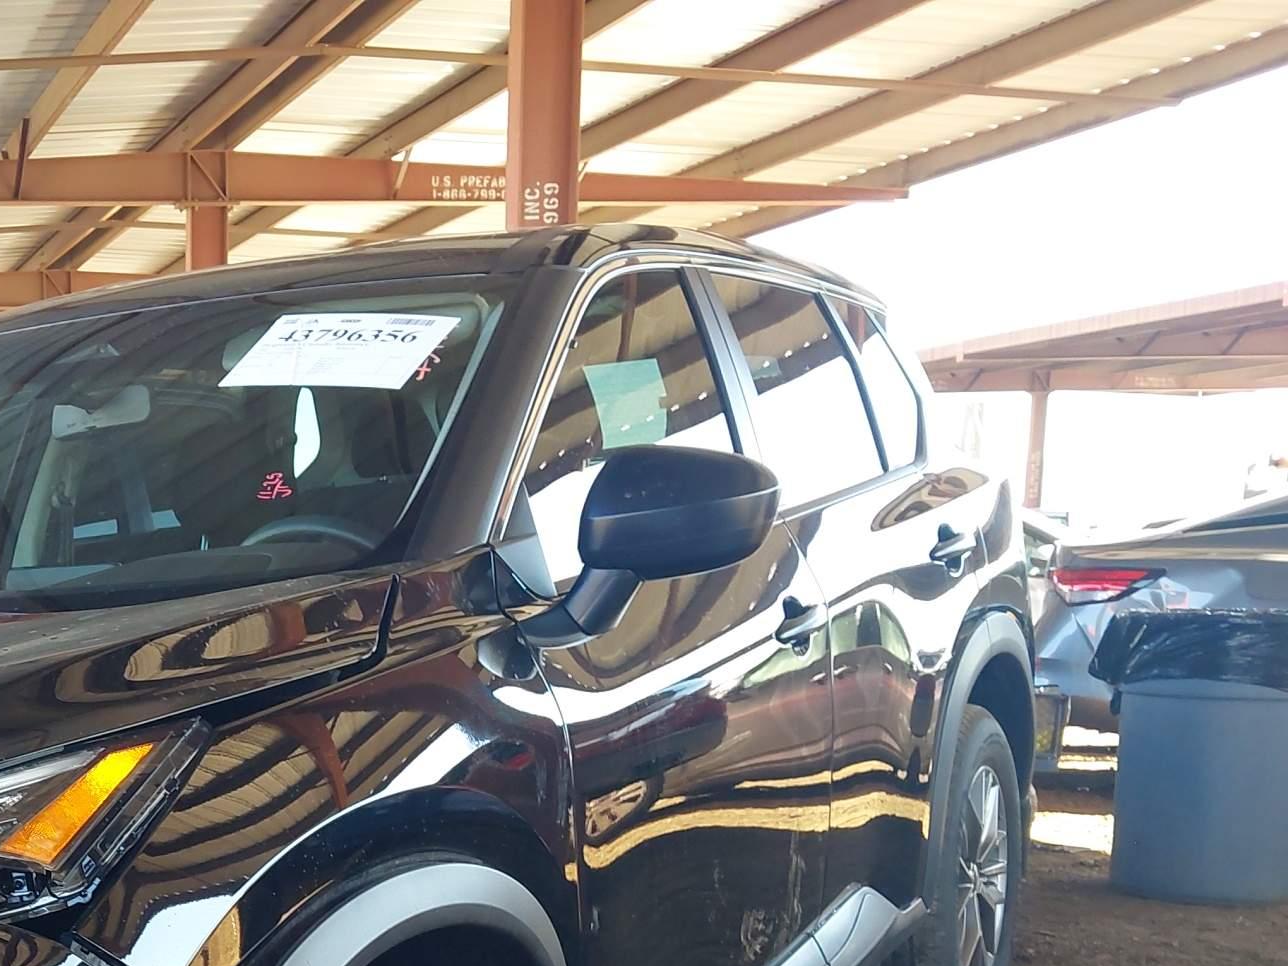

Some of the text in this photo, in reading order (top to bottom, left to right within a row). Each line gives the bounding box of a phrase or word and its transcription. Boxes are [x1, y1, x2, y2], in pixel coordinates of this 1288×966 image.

[460, 175, 507, 188] PREFAB
[524, 181, 540, 220] INC.
[543, 182, 560, 224] 969
[278, 328, 424, 344] 43796356
